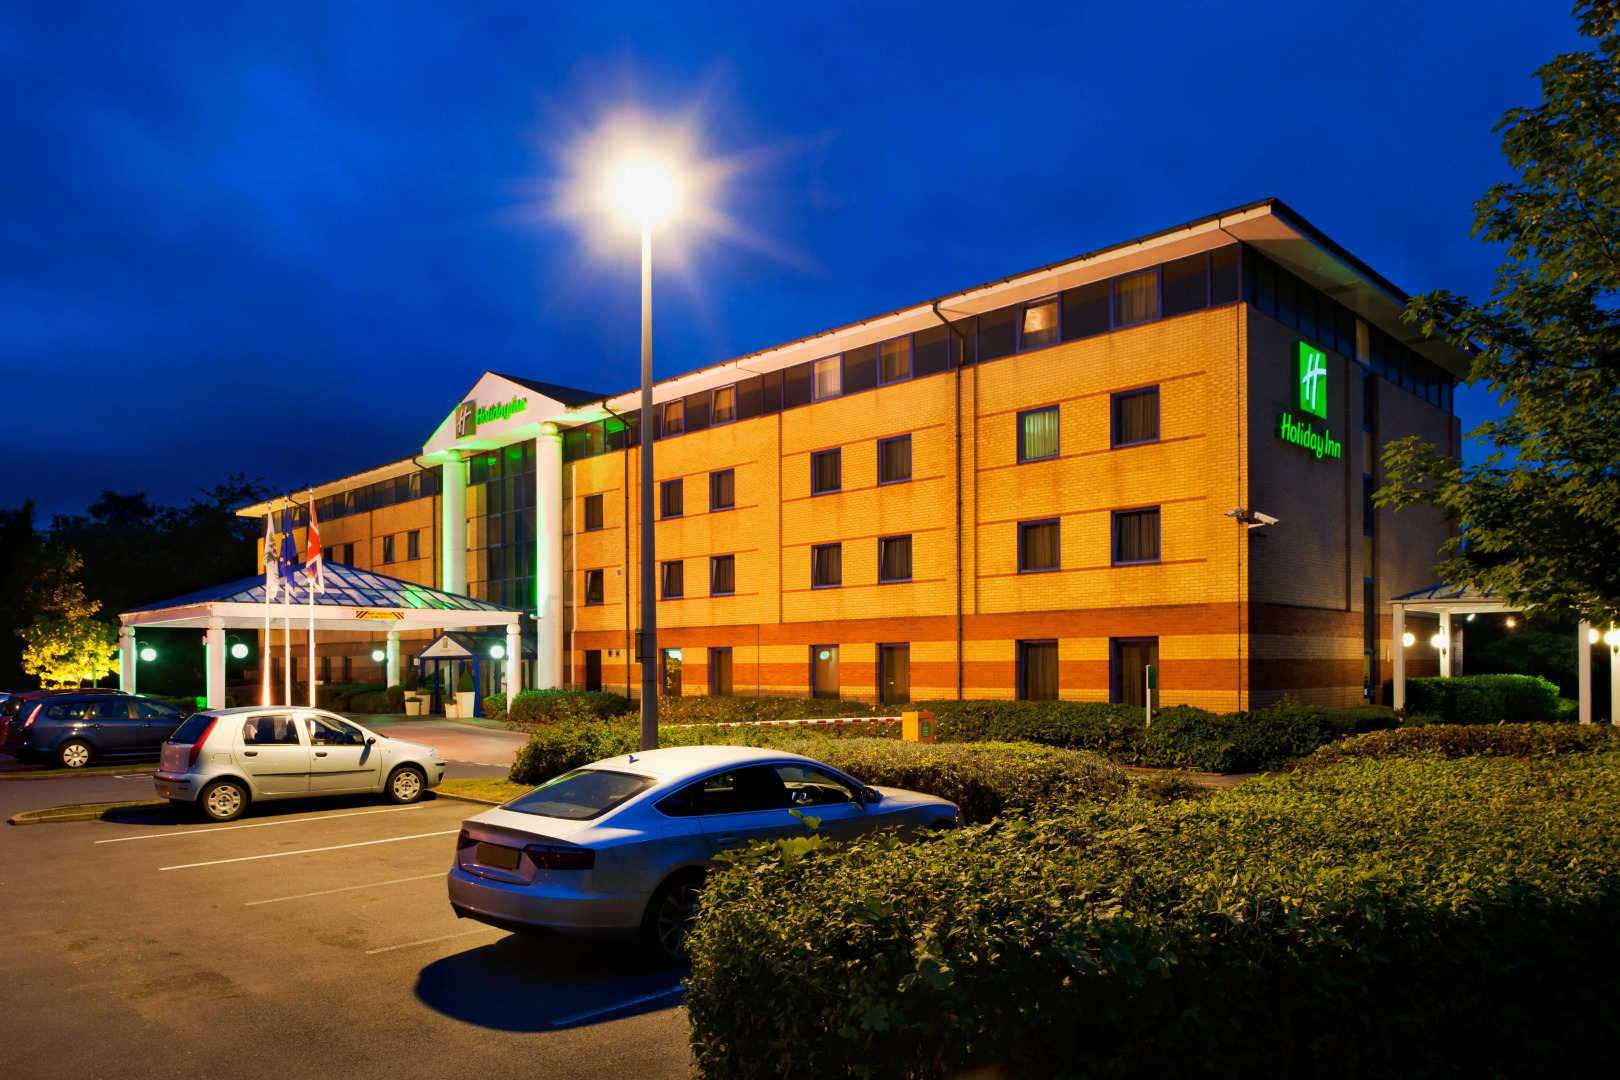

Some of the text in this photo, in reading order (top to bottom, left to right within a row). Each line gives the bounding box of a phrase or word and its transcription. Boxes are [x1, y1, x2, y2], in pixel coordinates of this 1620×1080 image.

[476, 397, 527, 425] Holiday Inn
[1281, 412, 1341, 459] Holiday Inn
